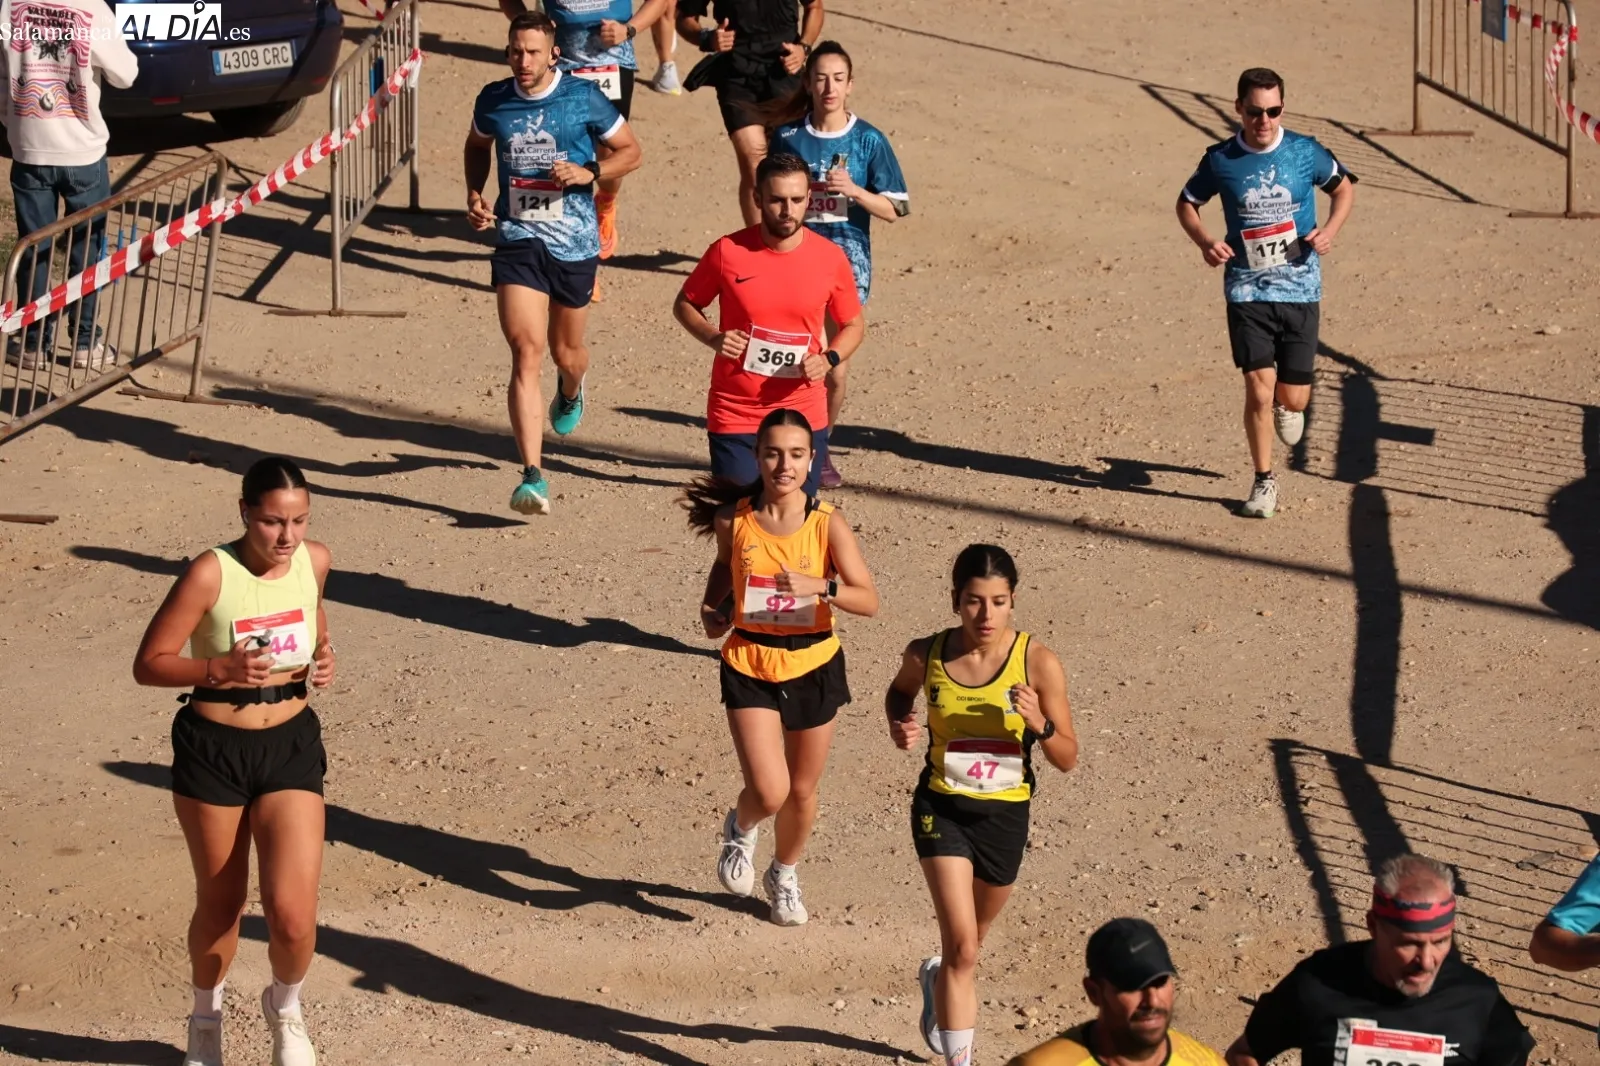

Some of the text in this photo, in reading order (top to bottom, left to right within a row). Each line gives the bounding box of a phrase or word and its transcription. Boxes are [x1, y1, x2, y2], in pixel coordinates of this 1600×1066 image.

[223, 46, 289, 70] 4309 CRC
[526, 146, 556, 154] Carrera
[517, 195, 551, 211] 121
[1261, 200, 1291, 209] Carrera
[757, 347, 796, 367] 369
[766, 595, 796, 613] 92
[966, 761, 1000, 780] 47
